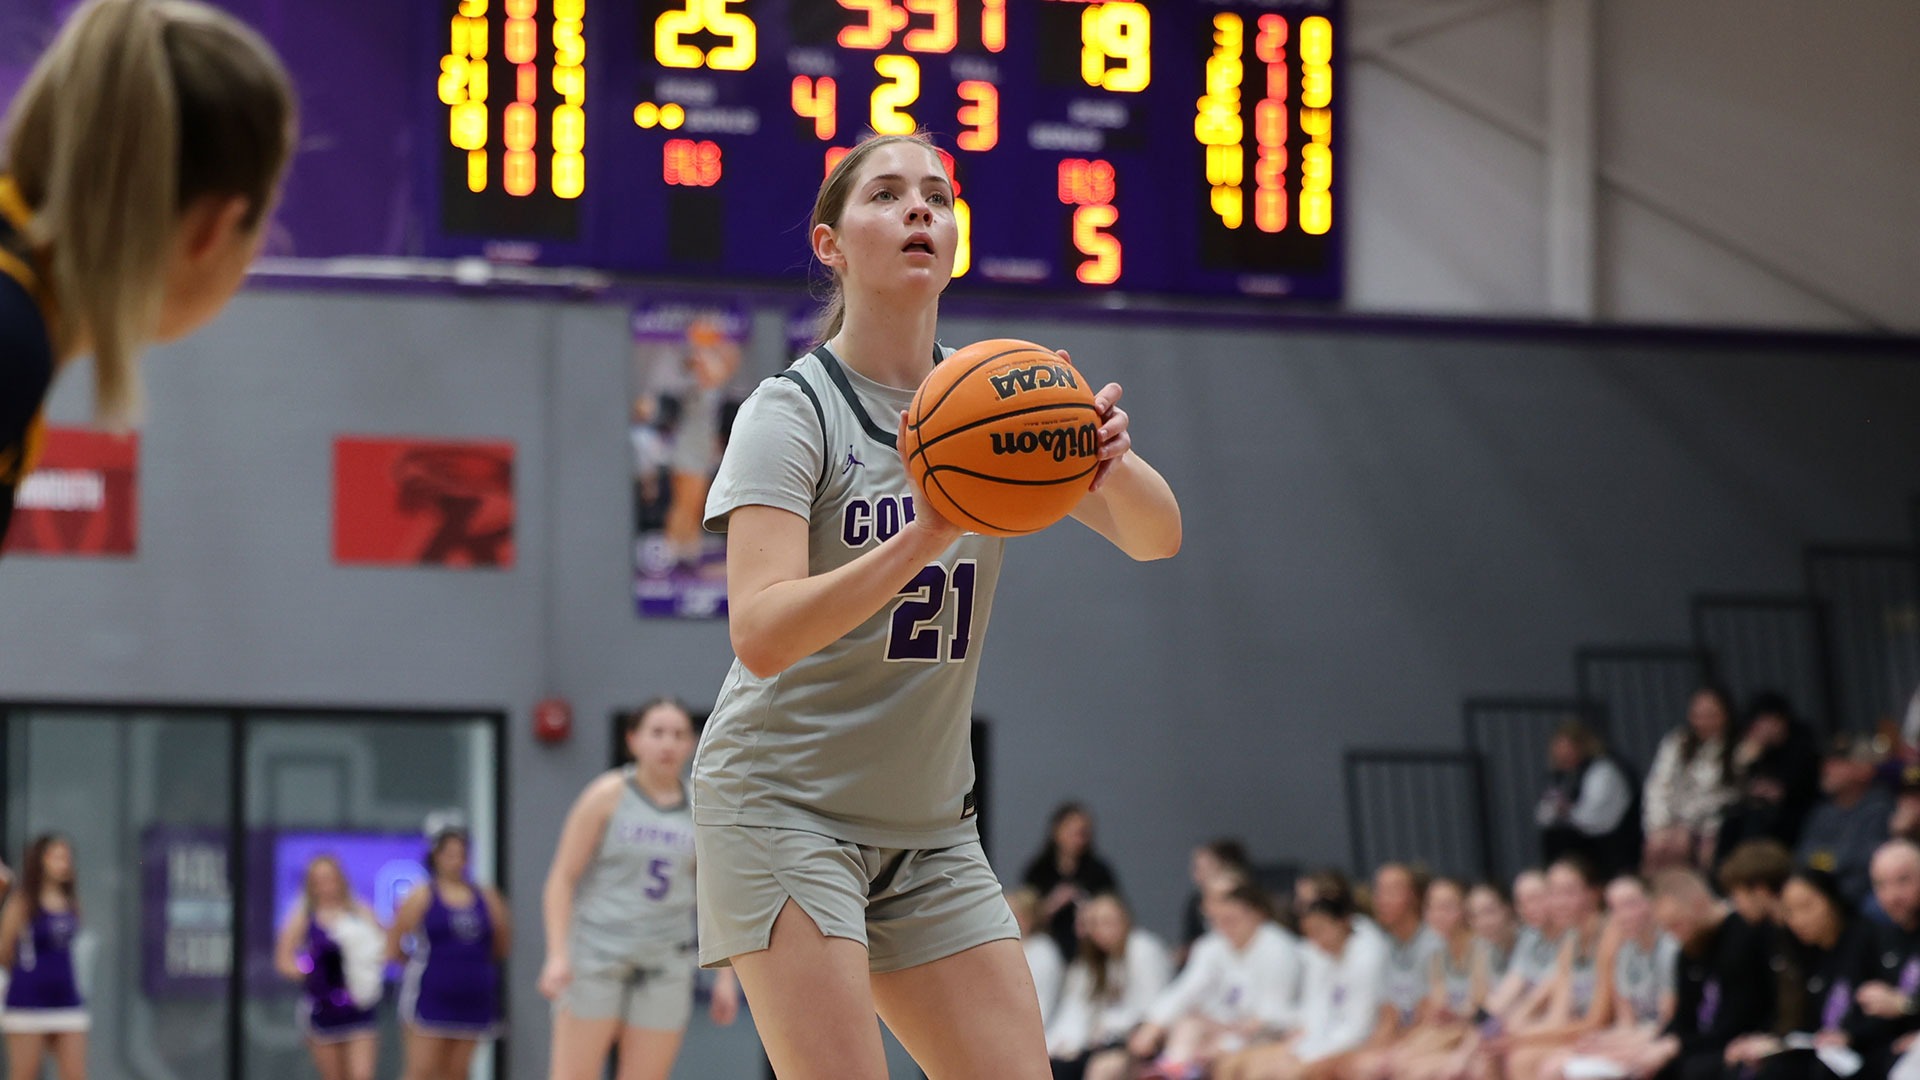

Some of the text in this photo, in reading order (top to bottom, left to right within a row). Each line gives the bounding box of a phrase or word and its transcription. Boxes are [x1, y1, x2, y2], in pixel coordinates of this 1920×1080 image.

[655, 0, 756, 71] 25
[1081, 2, 1150, 92] 19
[1256, 14, 1288, 62] 2
[792, 74, 836, 140] 4
[870, 54, 920, 135] 2
[957, 80, 998, 151] 3
[1073, 204, 1121, 284] 5
[988, 365, 1079, 400] NCAA
[990, 423, 1098, 462] Wilson
[883, 559, 977, 663] 21
[644, 858, 673, 901] 5
